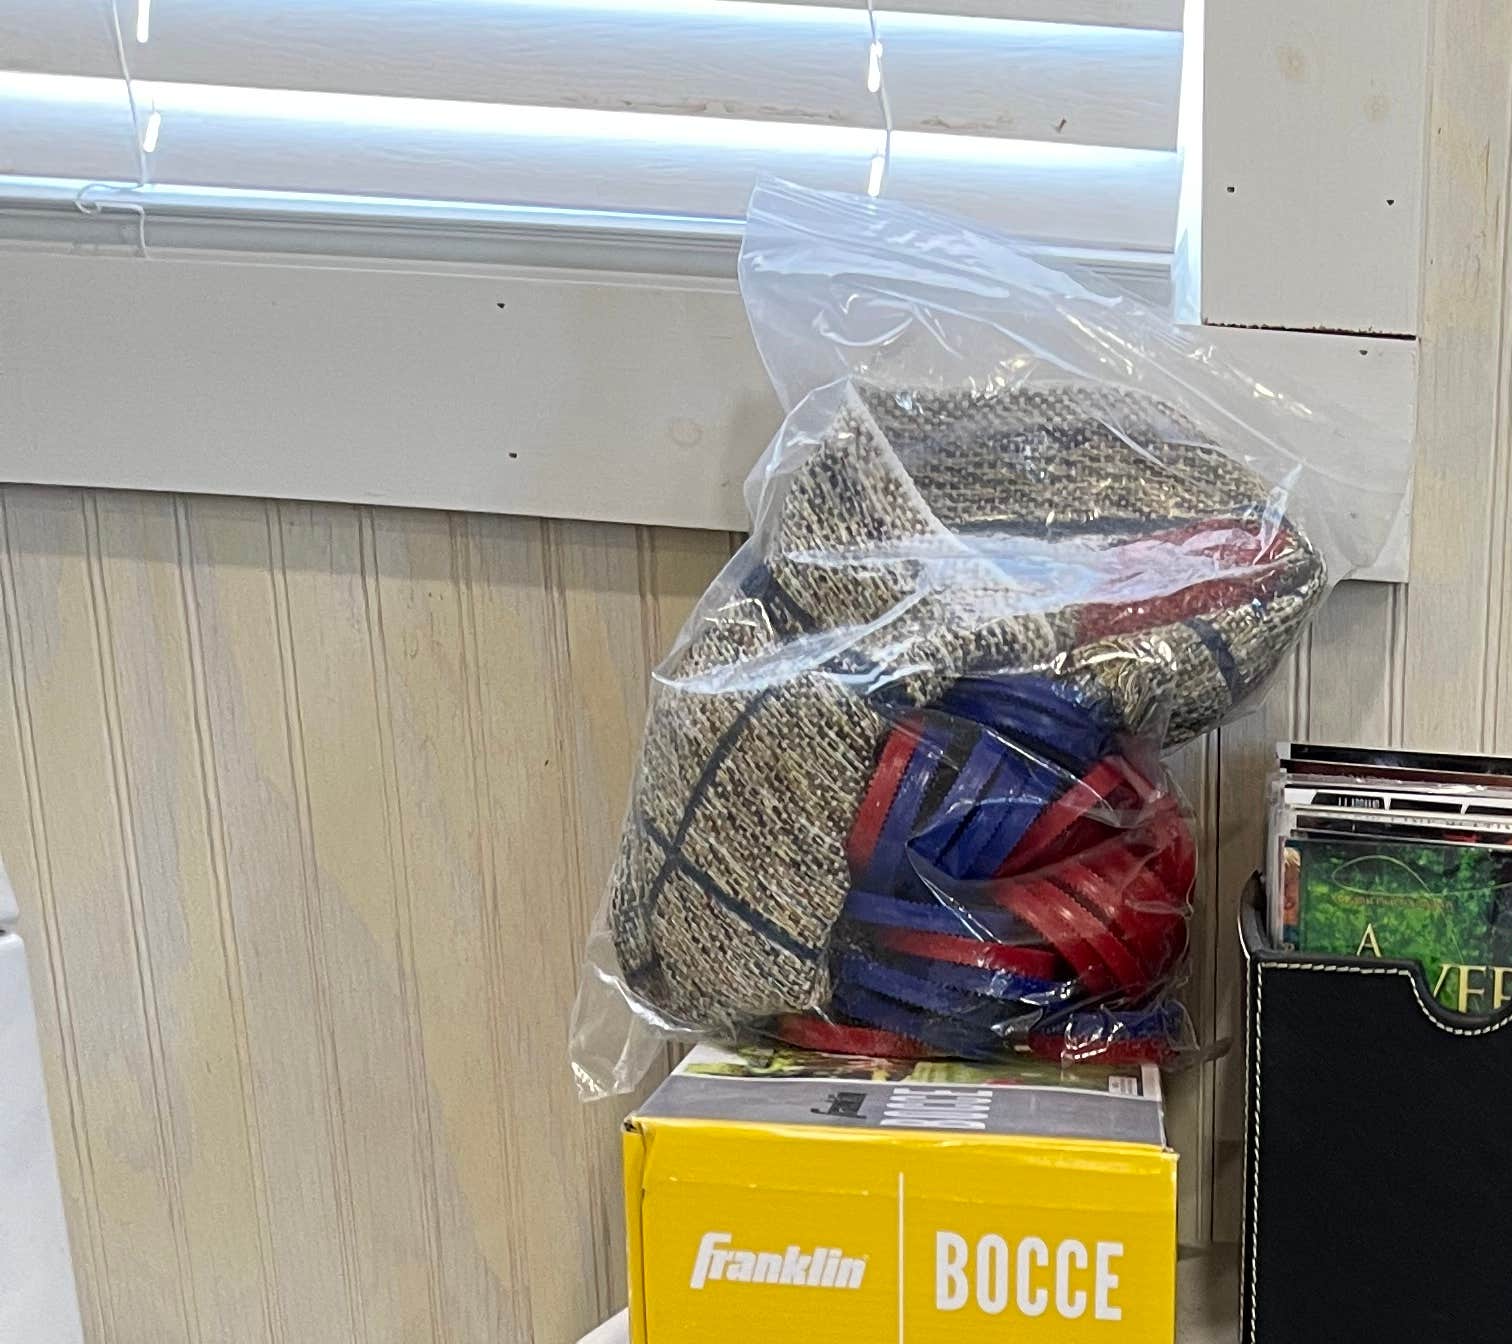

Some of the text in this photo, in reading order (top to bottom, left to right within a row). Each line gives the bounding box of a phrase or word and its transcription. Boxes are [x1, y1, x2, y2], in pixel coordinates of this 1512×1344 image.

[1356, 922, 1381, 958] A
[690, 1231, 868, 1290] franklin
[935, 1230, 1124, 1321] BOCCE
